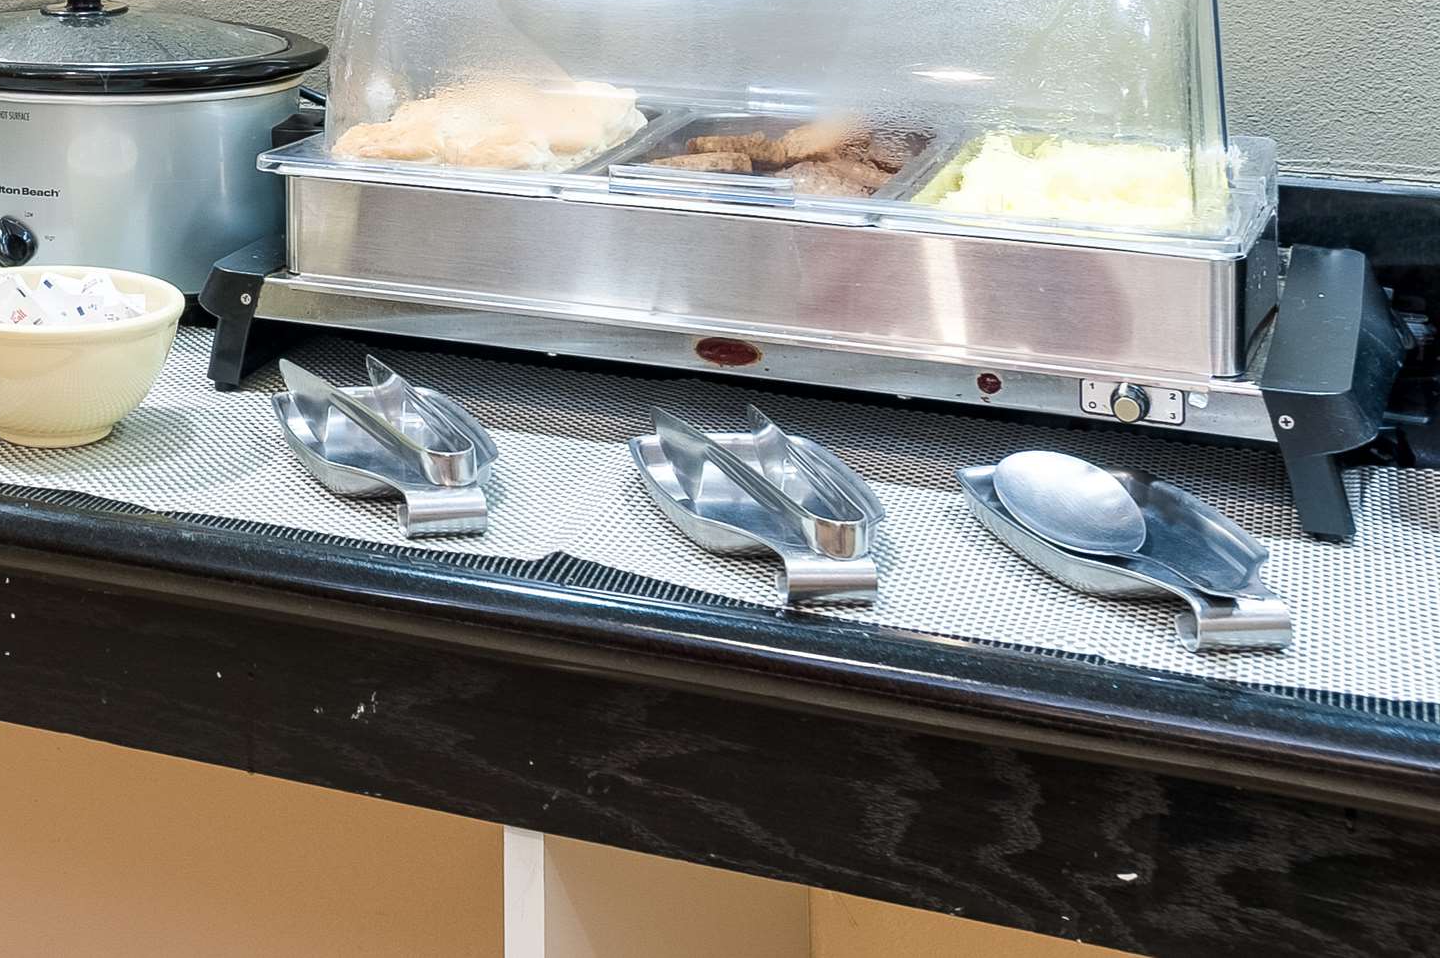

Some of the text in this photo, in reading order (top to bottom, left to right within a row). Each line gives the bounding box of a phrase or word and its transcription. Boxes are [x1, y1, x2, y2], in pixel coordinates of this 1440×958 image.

[21, 187, 59, 198] Beach
[1089, 382, 1095, 390] 1
[1169, 392, 1177, 401] 2
[1169, 412, 1177, 420] 3
